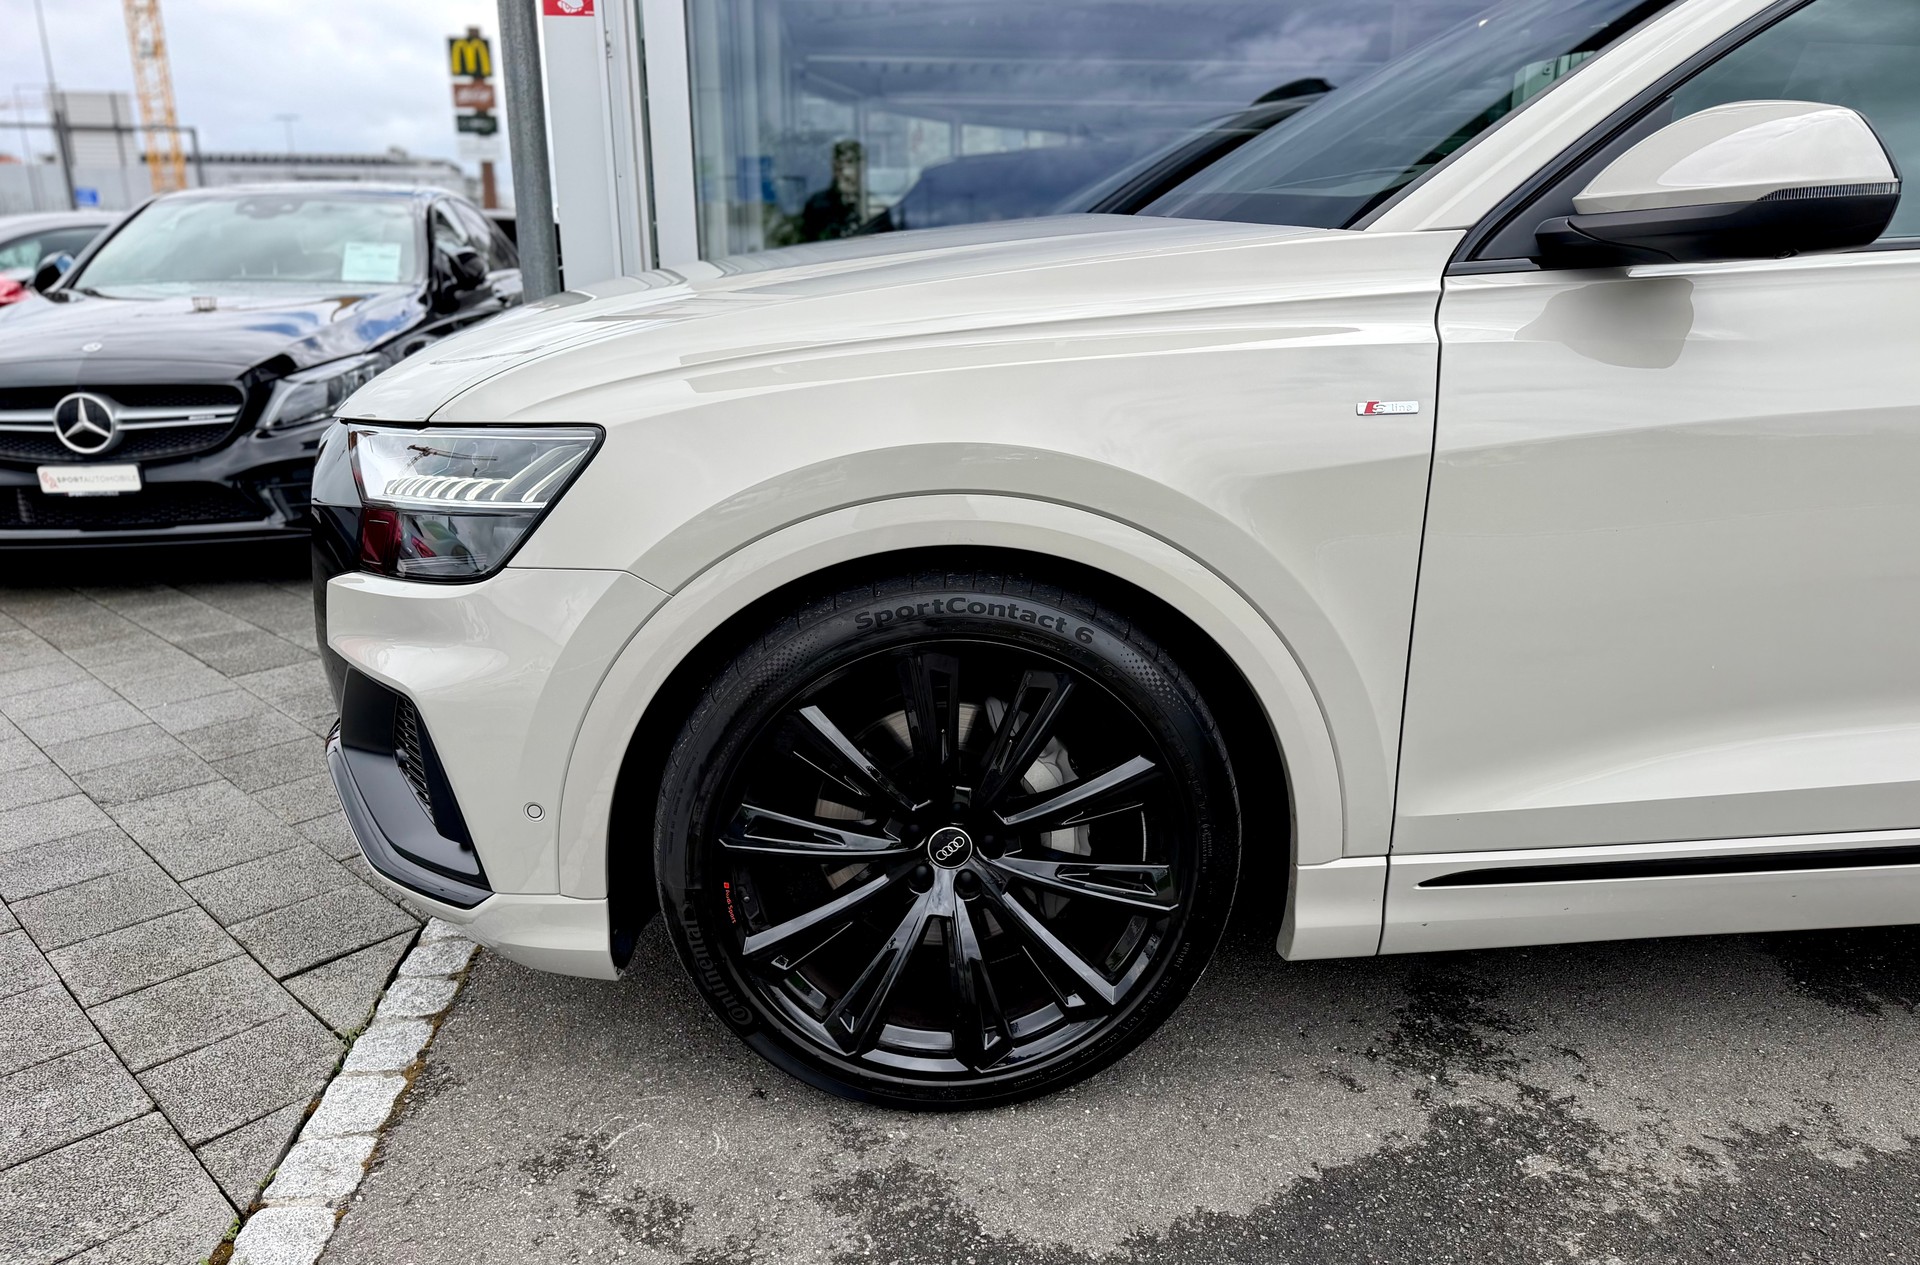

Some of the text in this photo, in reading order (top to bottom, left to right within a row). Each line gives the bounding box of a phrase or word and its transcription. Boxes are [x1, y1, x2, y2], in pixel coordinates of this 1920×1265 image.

[1391, 403, 1412, 411] line
[854, 597, 1067, 633] SportContact
[1074, 627, 1095, 644] 6
[728, 905, 737, 924] Sport
[681, 920, 753, 1025] Continental
